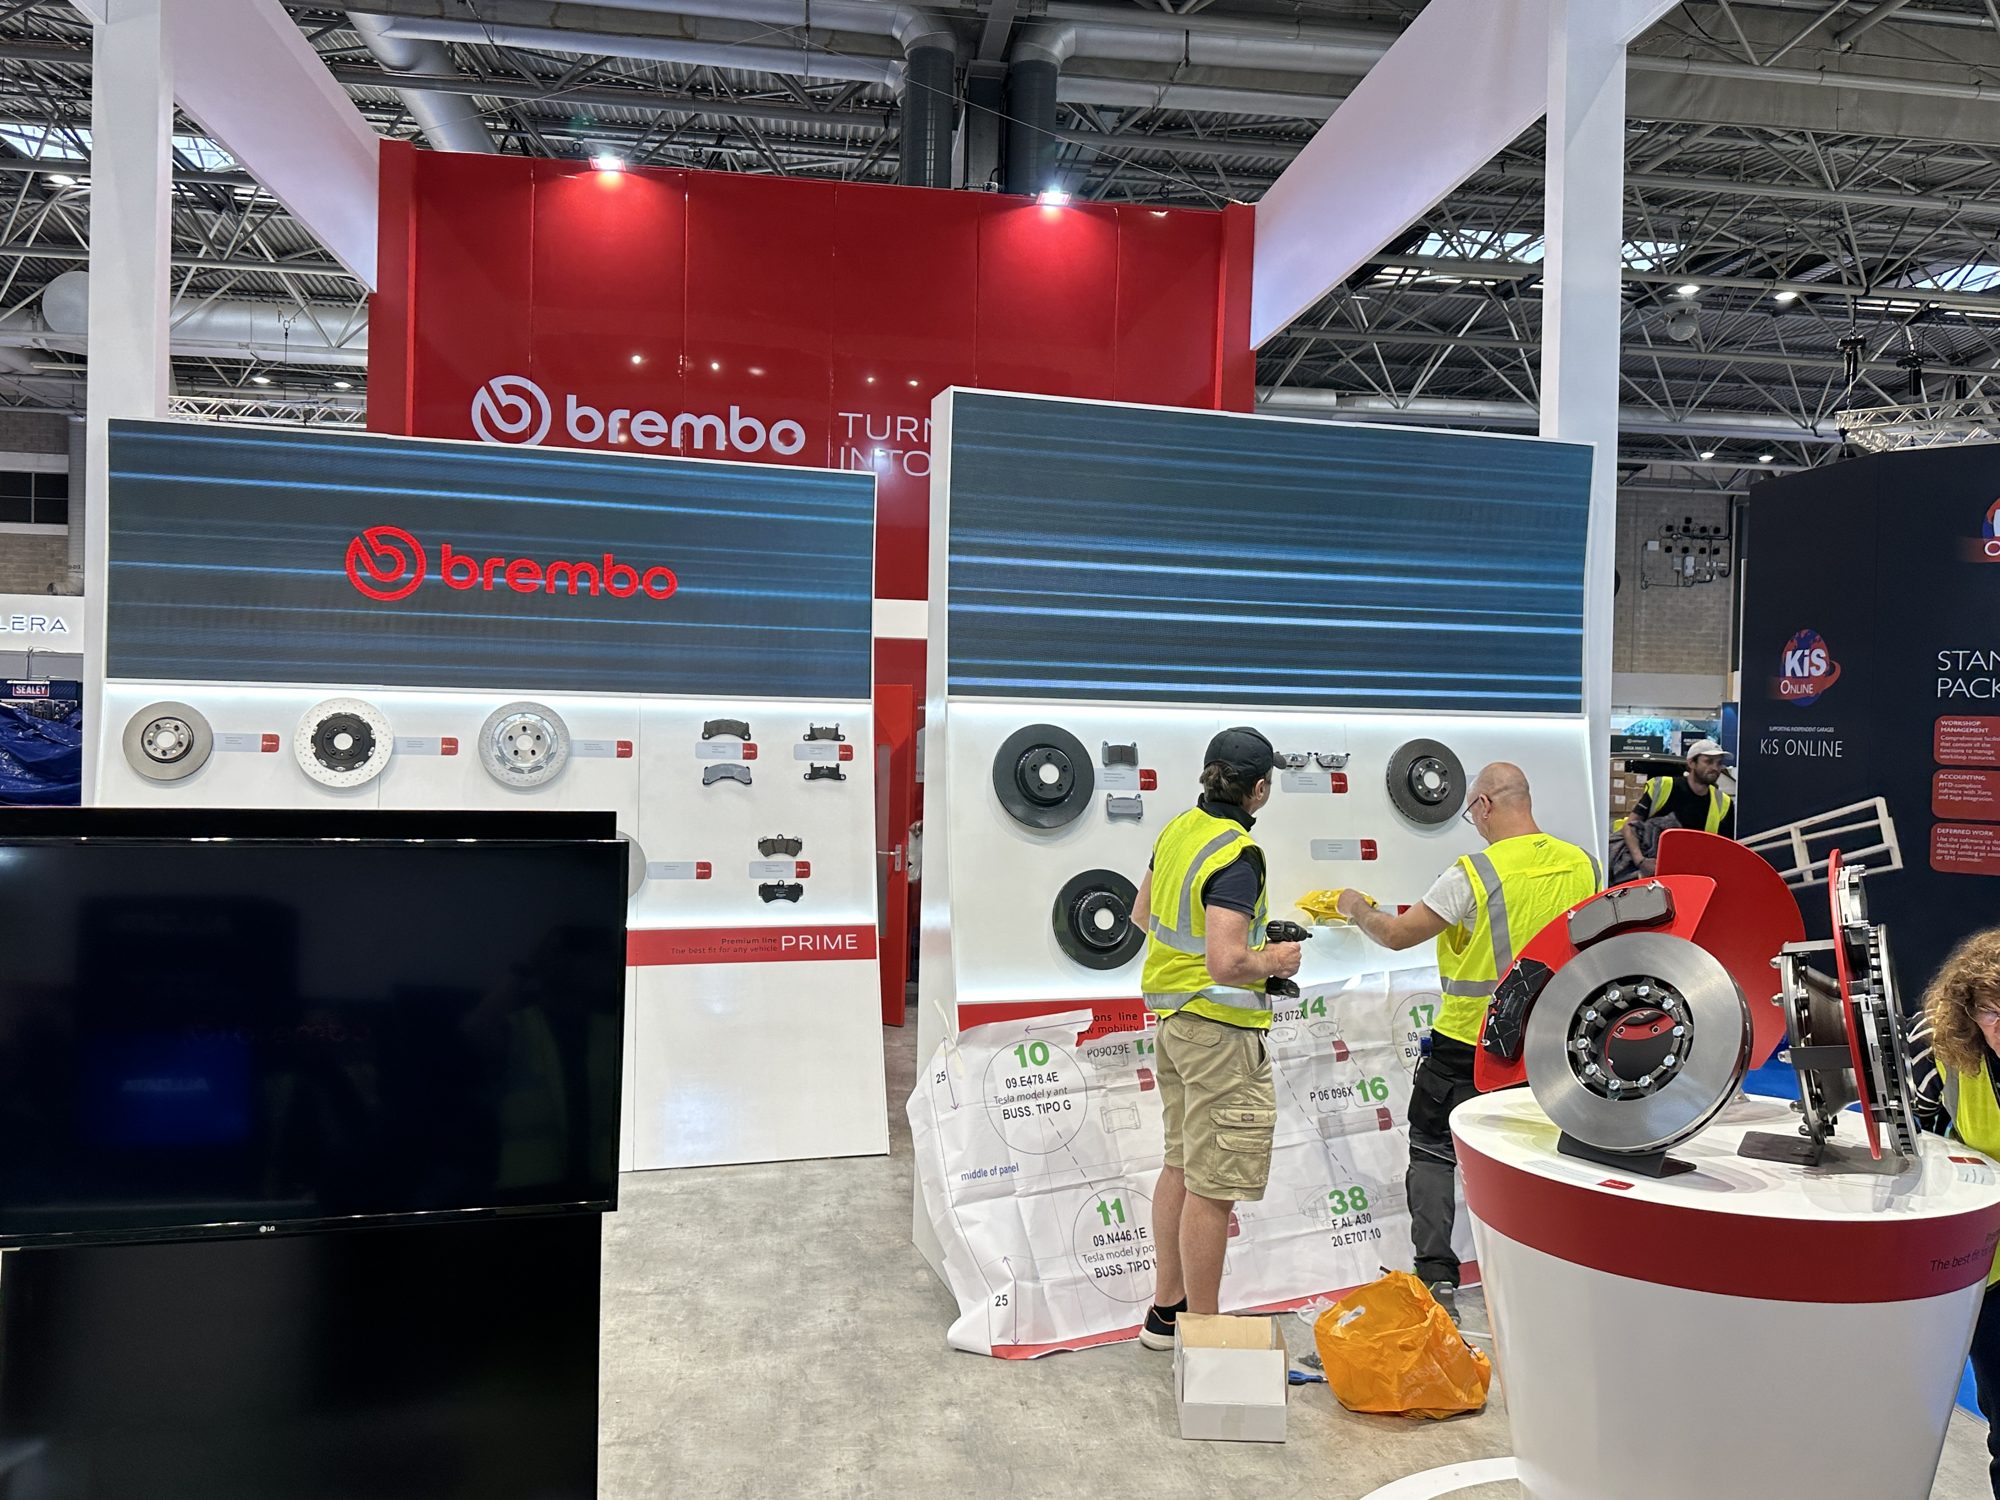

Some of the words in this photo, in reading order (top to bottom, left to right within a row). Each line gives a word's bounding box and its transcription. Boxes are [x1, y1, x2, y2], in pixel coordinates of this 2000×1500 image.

[567, 394, 806, 456] brembo
[841, 446, 932, 476] INTO
[441, 543, 678, 600] brembo
[1785, 648, 1827, 677] KiS
[16, 685, 46, 695] SEALEY
[1760, 738, 1779, 755] KiS
[1785, 739, 1843, 758] ONLINE
[1936, 827, 1971, 835] DEFERRED
[688, 946, 706, 954] best
[707, 946, 717, 954] fit
[719, 945, 731, 953] for
[732, 945, 748, 954] any
[749, 943, 778, 953] vehicle
[781, 933, 858, 952] PRIME
[1094, 1013, 1112, 1023] ons
[1119, 1011, 1139, 1021] line
[1285, 1009, 1306, 1021] 072X
[1299, 996, 1328, 1020] 14
[1408, 1004, 1435, 1029] 17
[1098, 1023, 1140, 1034] mobility
[1013, 1041, 1050, 1069] 10
[1087, 1043, 1131, 1059] P09029E
[1404, 1046, 1420, 1058] BU
[935, 1070, 947, 1085] 25
[1005, 1071, 1060, 1090] 09.E478.4E
[994, 1093, 1015, 1105] Tesla
[1016, 1089, 1045, 1103] model
[1046, 1090, 1052, 1099] y
[1053, 1086, 1068, 1096] ant
[1309, 1090, 1316, 1102] P
[1317, 1089, 1330, 1101] 06
[1331, 1086, 1354, 1101] 096X
[1355, 1076, 1389, 1103] 16
[1002, 1105, 1035, 1120] BUSS.
[1036, 1102, 1061, 1116] TIPO
[1062, 1099, 1072, 1111] G
[961, 1167, 988, 1181] middle
[989, 1167, 998, 1177] of
[999, 1162, 1020, 1176] panel
[1328, 1186, 1369, 1215] 38
[1096, 1198, 1126, 1226] 11
[1355, 1212, 1372, 1226] A30
[1093, 1227, 1148, 1247] 09.N446.1E
[1331, 1227, 1382, 1248] 20.E707.10
[1082, 1252, 1105, 1264] Tesla
[1106, 1246, 1134, 1261] model
[1134, 1246, 1141, 1256] y
[1142, 1243, 1157, 1255] po
[1930, 1258, 1950, 1272] The
[1951, 1254, 1971, 1268] best
[1094, 1265, 1126, 1279] BUSS.
[1127, 1260, 1151, 1274] TIPO
[994, 1294, 1009, 1307] 25
